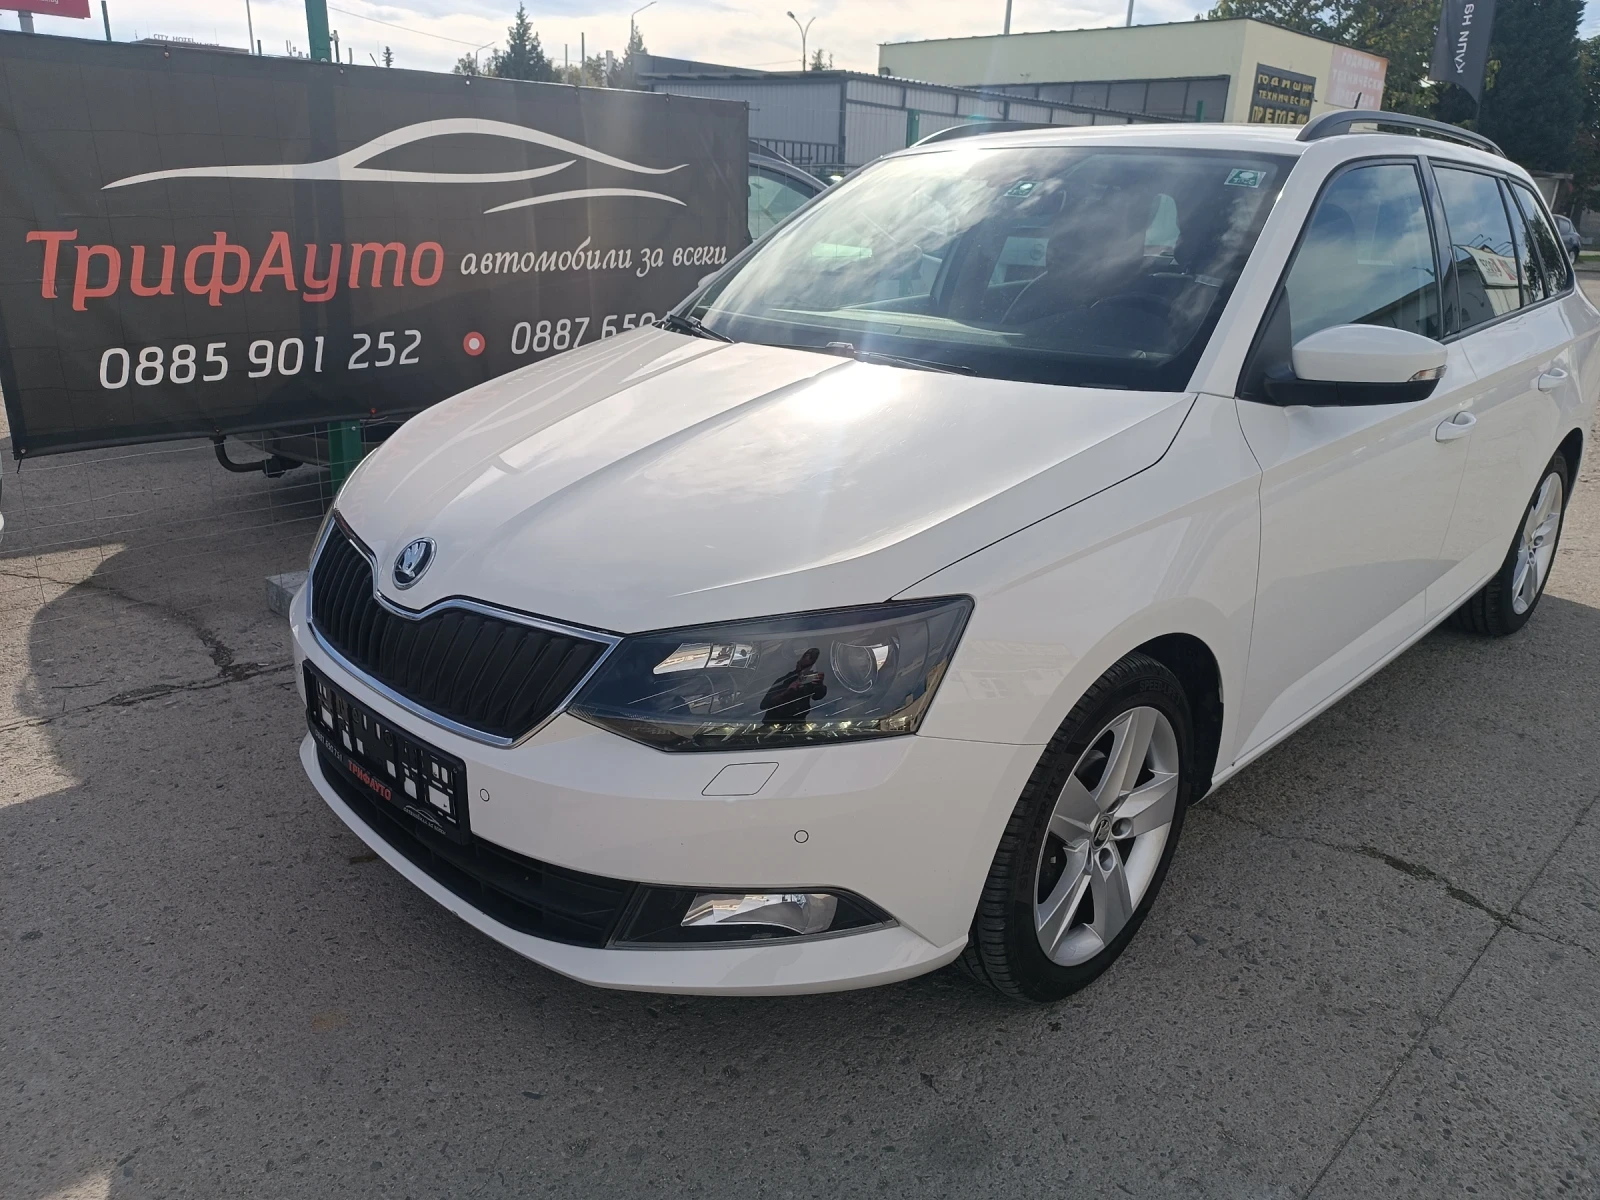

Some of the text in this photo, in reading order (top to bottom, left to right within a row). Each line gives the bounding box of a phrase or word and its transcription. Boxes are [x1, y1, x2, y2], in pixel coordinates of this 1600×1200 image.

[153, 33, 169, 41] CITY
[173, 36, 195, 44] HOTEL
[1257, 74, 1313, 93] ГОДИШНИ
[1258, 89, 1311, 107] ТЕХНИЧЕСКИ
[27, 231, 444, 311] ТрифАуто
[460, 236, 728, 278] автомобили за всеки
[511, 316, 591, 355] 0887
[99, 329, 422, 389] 0885 901 252
[348, 761, 392, 801] ТРИФАУТО
